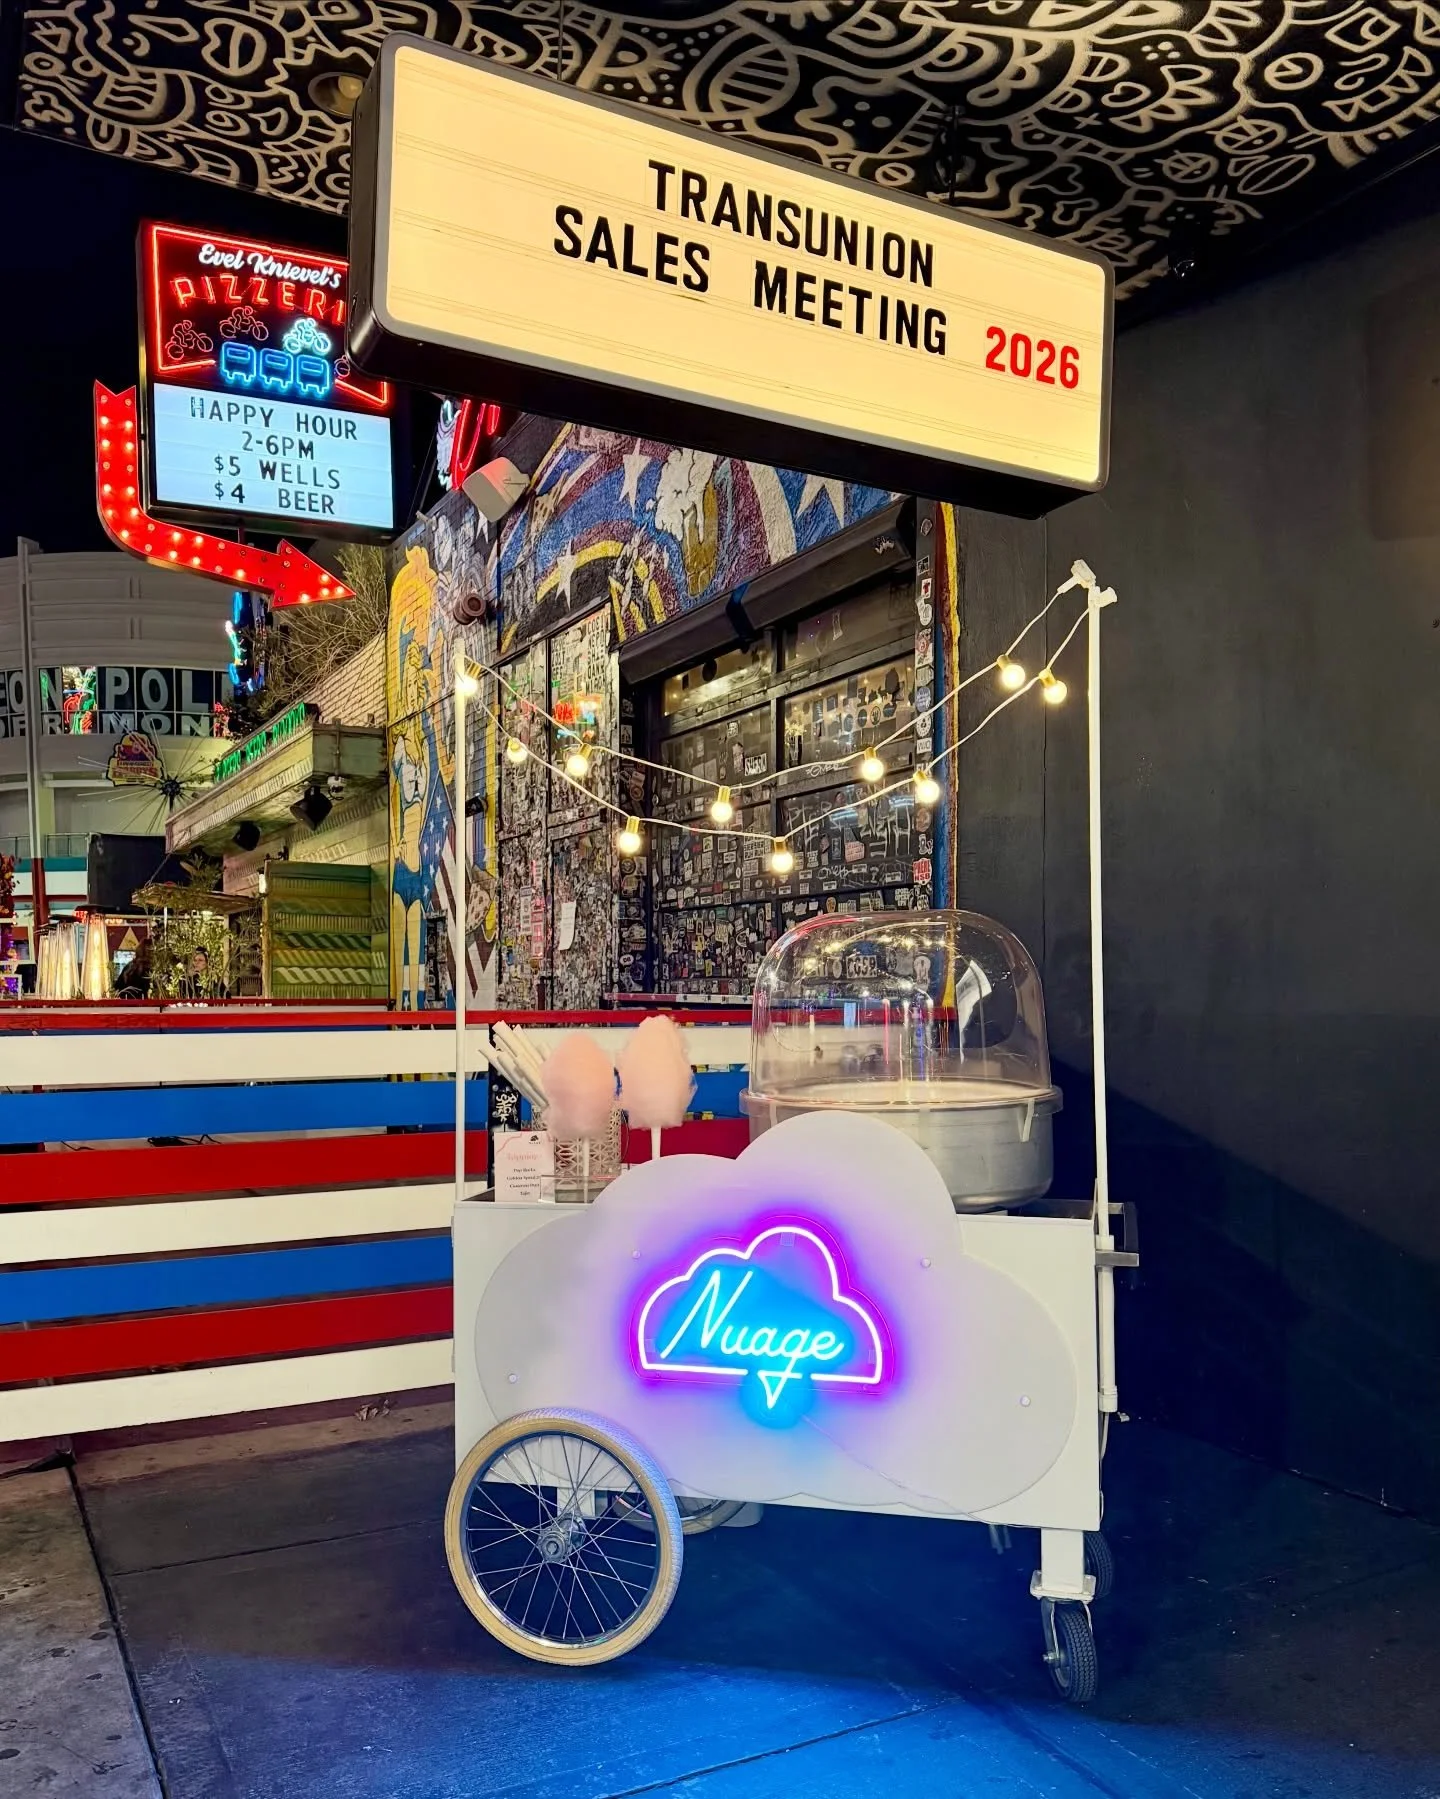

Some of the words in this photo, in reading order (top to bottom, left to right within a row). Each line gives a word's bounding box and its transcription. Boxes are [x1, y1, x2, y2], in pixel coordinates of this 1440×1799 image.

[648, 159, 934, 288] TRANSUNION
[198, 243, 244, 271] Evel
[247, 252, 342, 289] Knievel's
[170, 273, 346, 325] PIZZERI
[553, 204, 710, 293] SALES
[753, 259, 947, 356] MEETING
[985, 326, 1080, 389] 2026
[190, 396, 274, 428] HAPPY
[296, 412, 358, 441] HOUR
[242, 430, 314, 461] 2-6PM
[259, 459, 340, 490] WELLS
[278, 487, 335, 515] BEER
[659, 1269, 845, 1409] Nuage
